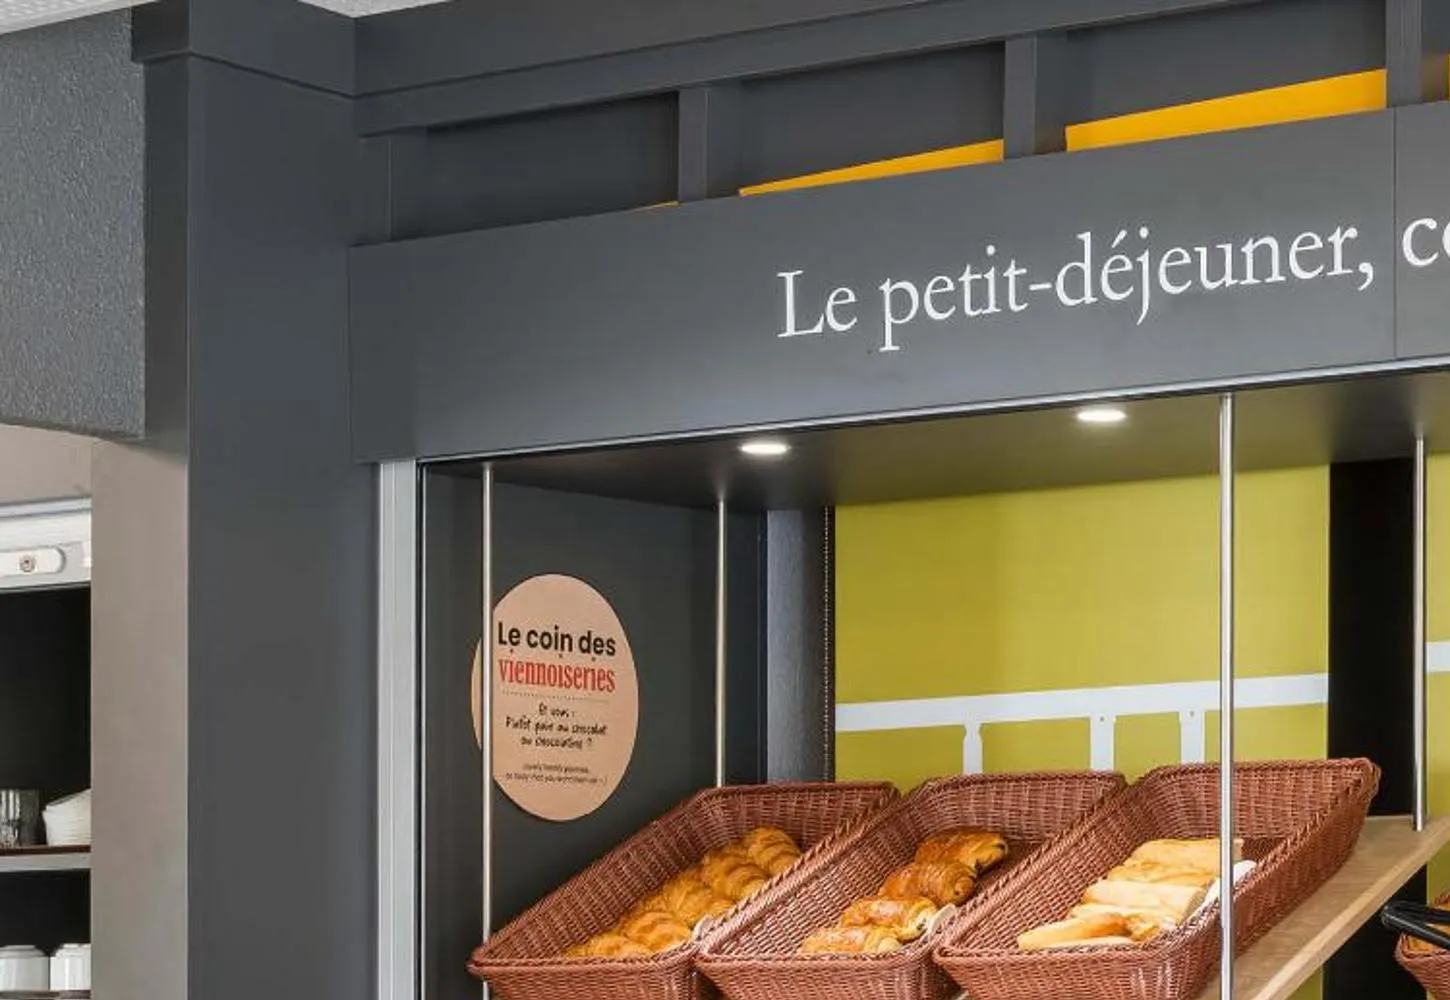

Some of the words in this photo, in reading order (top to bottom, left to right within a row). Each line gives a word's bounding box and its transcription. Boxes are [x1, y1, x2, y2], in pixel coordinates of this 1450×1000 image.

[778, 271, 857, 337] Le
[880, 227, 1373, 352] petit-déjeuner,
[498, 621, 521, 646] Le
[526, 625, 573, 652] coin
[578, 630, 616, 656] des
